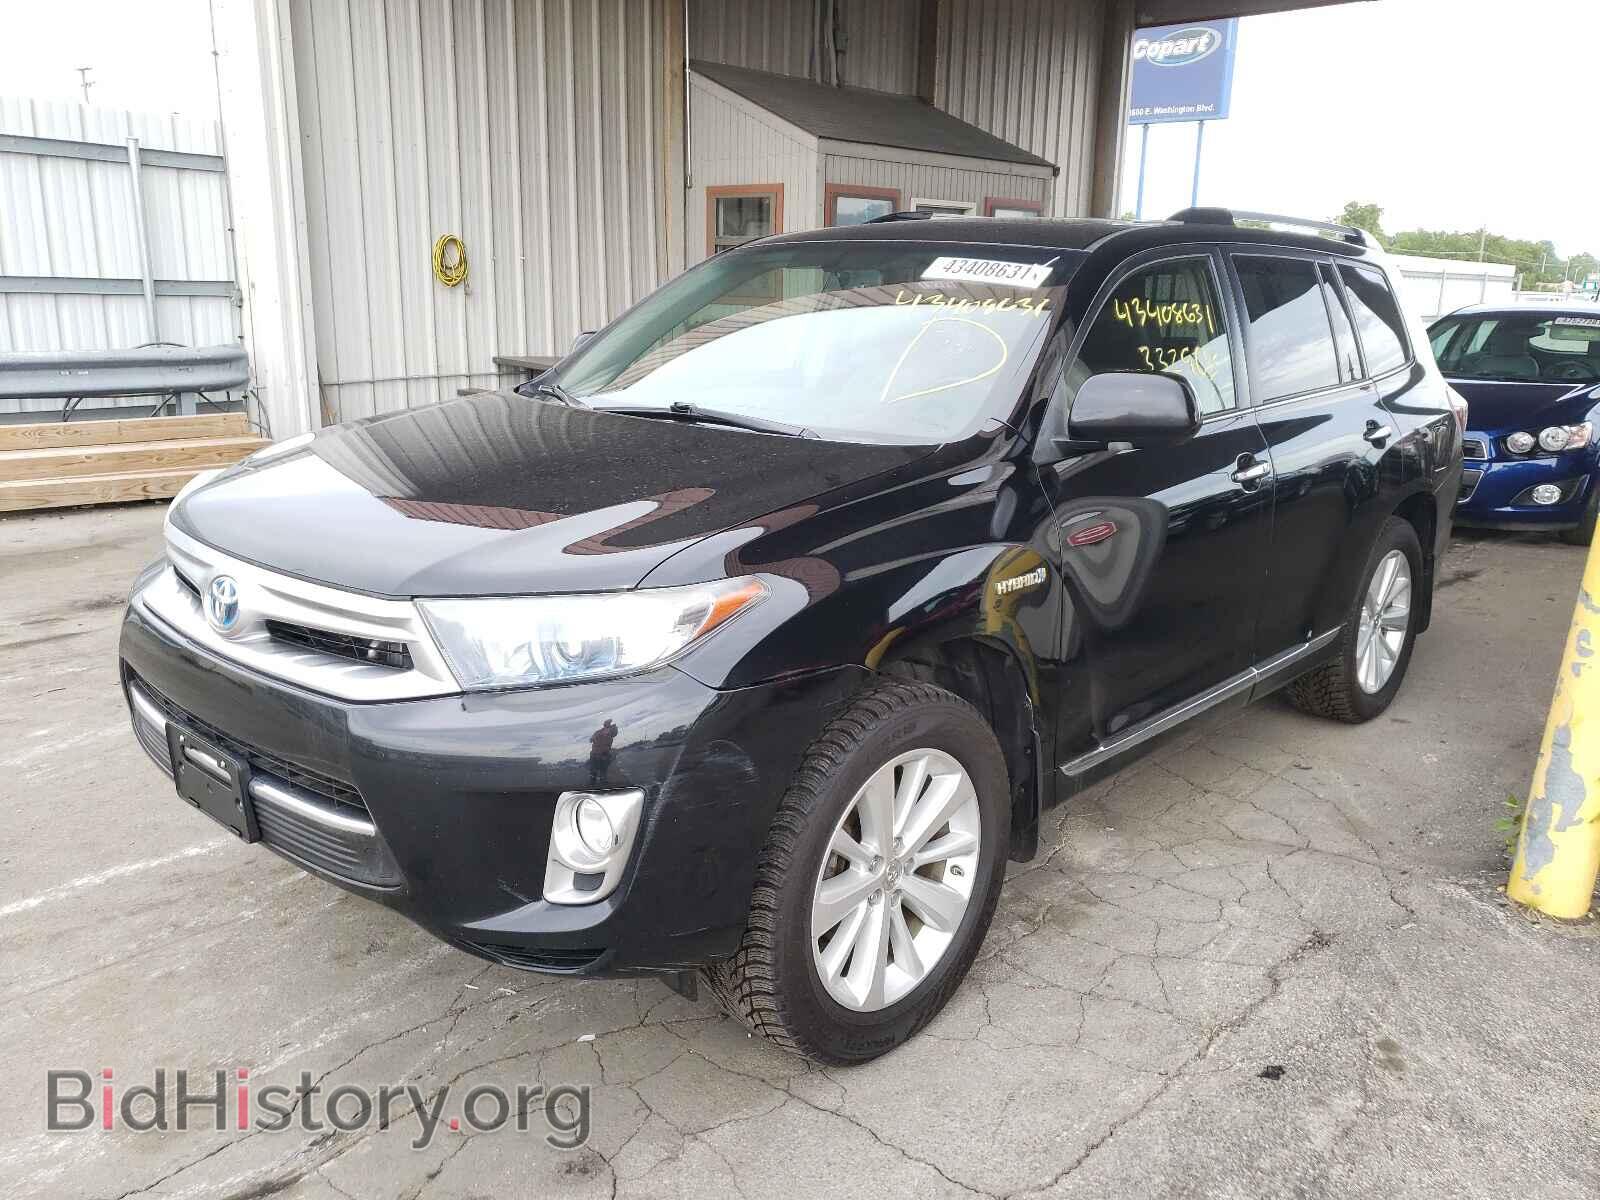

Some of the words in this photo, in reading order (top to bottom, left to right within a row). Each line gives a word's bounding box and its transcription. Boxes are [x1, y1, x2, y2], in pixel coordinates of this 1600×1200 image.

[1134, 31, 1212, 61] Copart
[1154, 104, 1195, 114] Washington
[1196, 103, 1216, 113] Blvd.
[943, 258, 1031, 280] 43408631
[1115, 298, 1214, 334] 43408631
[994, 567, 1046, 595] HYBRID
